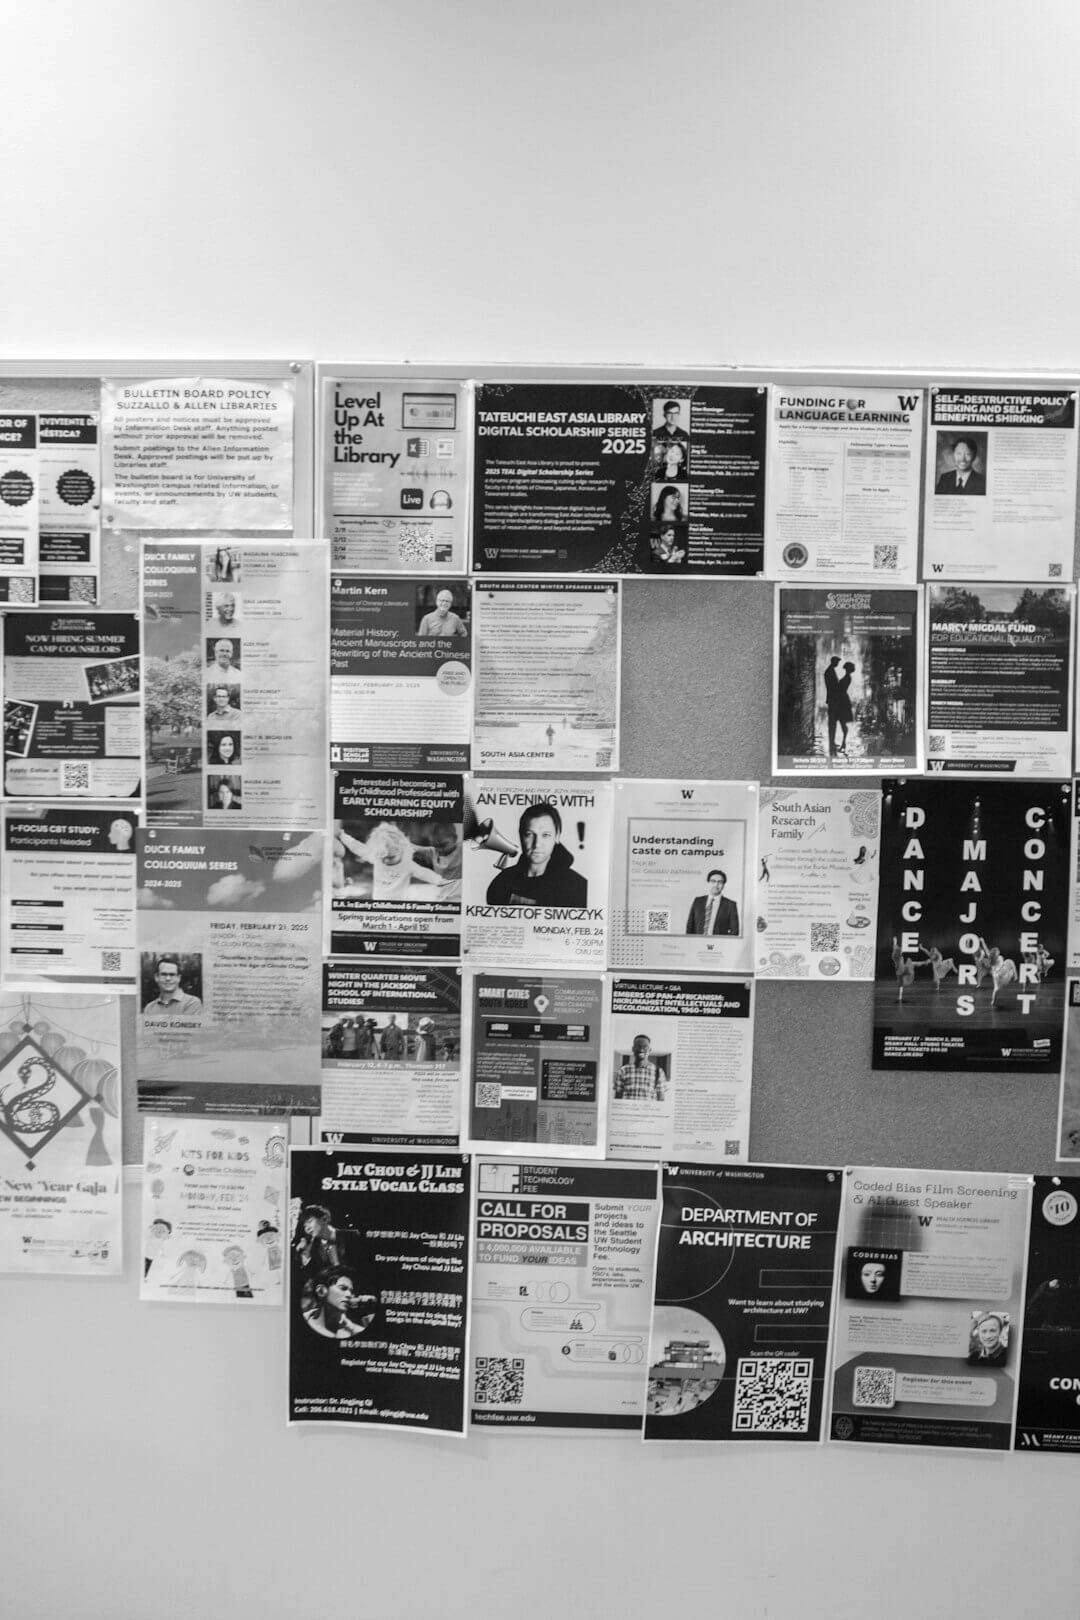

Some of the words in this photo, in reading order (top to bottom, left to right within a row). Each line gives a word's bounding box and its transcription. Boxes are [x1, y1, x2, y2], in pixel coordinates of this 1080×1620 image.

[228, 390, 270, 398] POLICY
[335, 392, 380, 408] Level
[780, 398, 835, 407] FUNDING
[935, 395, 1032, 405] SELF-DESTRUCTIVE
[1033, 396, 1068, 406] POLICY
[935, 404, 978, 413] SEEKING
[978, 405, 1001, 413] AND
[335, 410, 359, 430] Up
[364, 411, 384, 426] At
[478, 412, 536, 422] TATEUCHI
[538, 412, 568, 422] EAST
[568, 413, 596, 423] ASIA
[597, 413, 646, 423] LIBRARY
[780, 411, 845, 420] LANGUAGE
[848, 413, 909, 422] LEARNING
[934, 413, 994, 422] BENEFITING
[996, 414, 1044, 423] SHIRKING
[334, 428, 362, 444] the
[478, 426, 524, 436] DIGITAL
[526, 427, 606, 437] SCHOLARSHIP
[608, 427, 646, 437] SERIES
[602, 438, 646, 454] 2025
[334, 446, 400, 468] Library
[403, 495, 422, 504] Live
[332, 586, 362, 594] Martin
[932, 623, 967, 633] MARCY
[968, 623, 1007, 632] MIGDAL
[1008, 623, 1036, 633] FUND
[365, 640, 417, 650] Manuscripts
[331, 650, 370, 659] Rewriting
[434, 650, 470, 658] Chinese
[477, 794, 496, 804] AN
[500, 794, 557, 806] EVENING
[560, 795, 594, 806] WITH
[682, 790, 694, 799] W
[343, 797, 372, 805] EARLY
[373, 798, 419, 807] LEARNING
[421, 800, 455, 808] EQUITY
[772, 803, 801, 812] South
[804, 804, 831, 813] Asian
[364, 808, 433, 817] SCHOLARSHIP?
[772, 816, 815, 825] Research
[772, 829, 804, 840] Family
[633, 836, 714, 845] Understanding
[144, 845, 170, 853] DUCK
[172, 846, 205, 854] FAMILY
[144, 860, 207, 869] COLLOQUIUM
[209, 862, 238, 870] SERIES
[901, 807, 926, 952] DANCE
[467, 906, 541, 919] KRZYSZTOF
[544, 907, 603, 919] SIWCZYK
[1017, 807, 1046, 1014] CONCERT
[956, 840, 987, 1016] MAJORS
[361, 973, 399, 981] QUARTER
[406, 1164, 420, 1177] &
[422, 1164, 433, 1178] JJ
[524, 1176, 574, 1184] TECHNOLOGY
[5, 1180, 32, 1191] New
[36, 1181, 73, 1192] Year
[76, 1182, 106, 1196] Gala
[854, 1180, 892, 1192] Coded
[896, 1183, 922, 1193] Bias
[926, 1184, 953, 1194] Film
[957, 1186, 1018, 1200] Screening
[854, 1195, 863, 1204] &
[885, 1196, 919, 1207] Guest
[924, 1198, 971, 1209] Speaker
[481, 1202, 526, 1217] CALL
[531, 1204, 566, 1218] FOR
[682, 1208, 793, 1225] DEPARTMENT
[796, 1213, 817, 1226] OF
[481, 1223, 587, 1240] PROPOSALS
[679, 1231, 811, 1248] ARCHITECTURE
[475, 1414, 536, 1422] techfee.uw.edu
